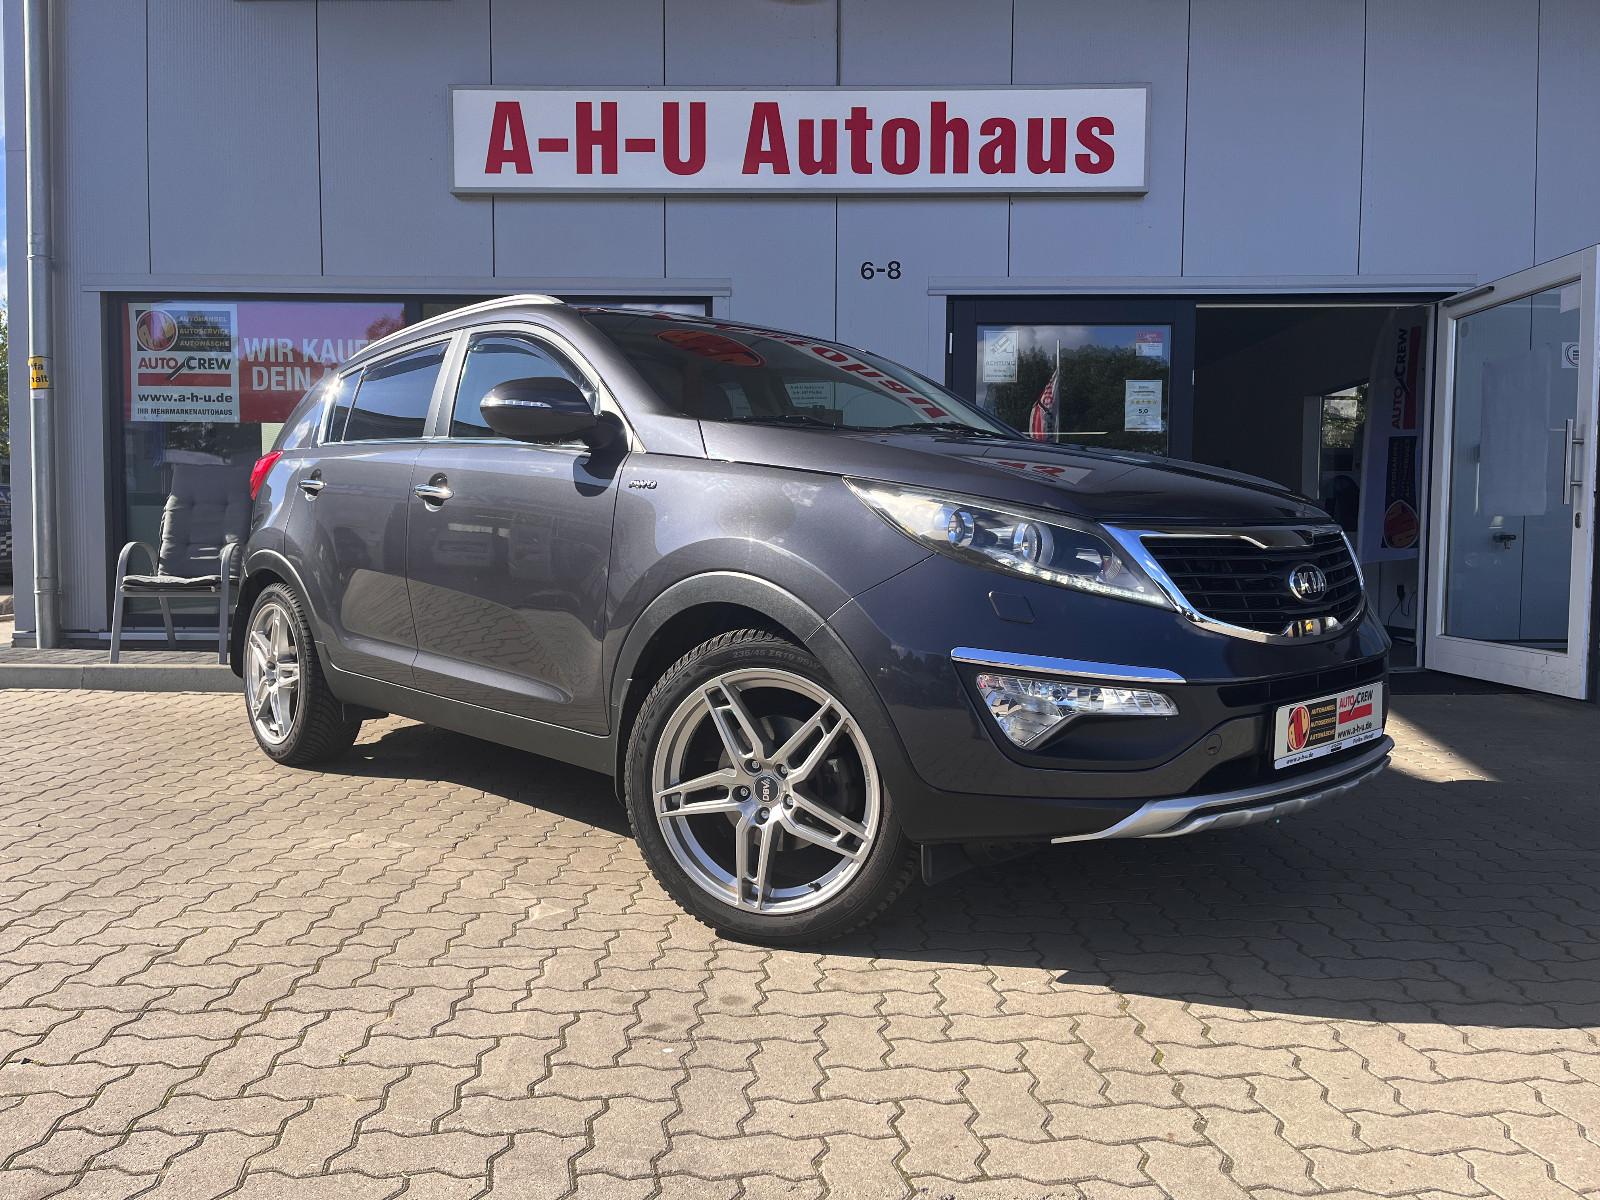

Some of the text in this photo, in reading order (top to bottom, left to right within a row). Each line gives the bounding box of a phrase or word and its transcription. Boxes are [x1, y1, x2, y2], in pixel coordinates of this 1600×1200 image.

[485, 101, 1115, 175] A-H-U Autohaus
[860, 260, 902, 280] 6-8
[243, 337, 377, 363] WIR KAUF
[252, 366, 311, 391] DEIN
[137, 392, 233, 403] www.a-h-u.de
[150, 408, 233, 416] MEHRMARKENAUTOHAUS
[1297, 571, 1325, 594] KIA
[1337, 721, 1373, 739] www.a-h-u.de
